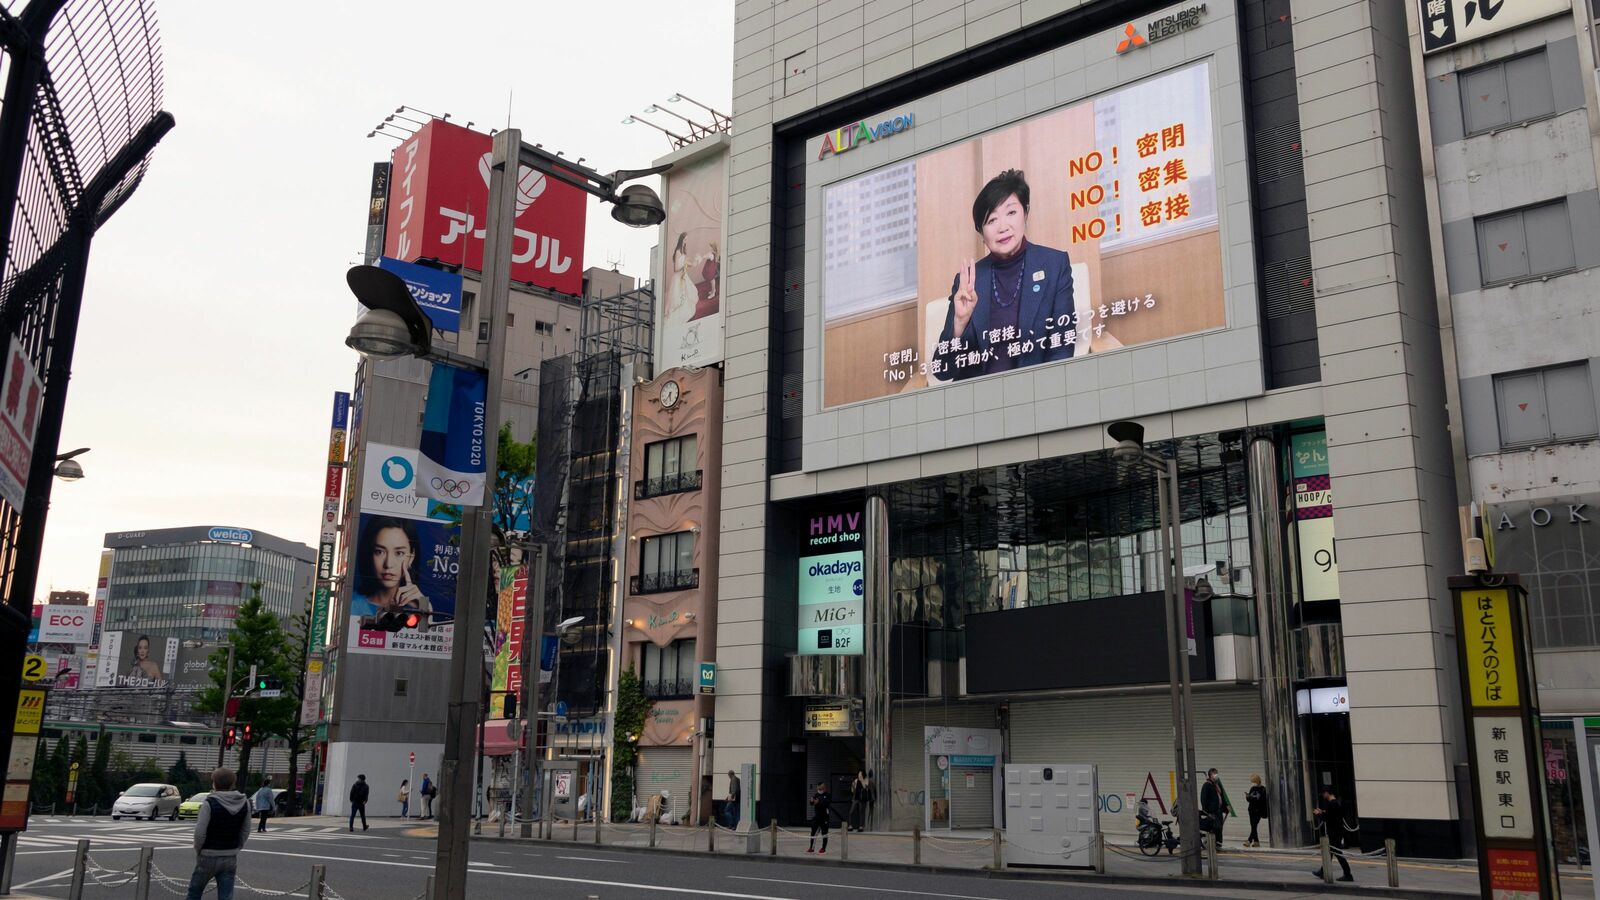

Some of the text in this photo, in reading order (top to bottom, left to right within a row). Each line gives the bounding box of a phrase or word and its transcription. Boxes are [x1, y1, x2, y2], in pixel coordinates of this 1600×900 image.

[1148, 3, 1206, 32] MITSUBISHI
[1148, 16, 1199, 42] ELECTRIC
[818, 112, 913, 161] ALTA VISION
[1136, 123, 1185, 158] 密閉
[1138, 159, 1188, 192] 密集
[396, 139, 419, 260] アイフル
[1140, 193, 1190, 227] 密接
[439, 206, 572, 274] アフル
[470, 401, 485, 466] TOKYO 2020
[370, 489, 420, 508] eyecity
[212, 530, 249, 542] welcia
[810, 512, 860, 535] HMV
[810, 532, 860, 546] record shop
[808, 560, 861, 576] okadaya
[49, 615, 84, 626] ECC
[835, 638, 851, 648] B2F
[1477, 596, 1502, 701] はとバスのりば
[25, 657, 42, 677] 2
[183, 660, 207, 673] global
[1491, 726, 1515, 829] 新宿駅東口
